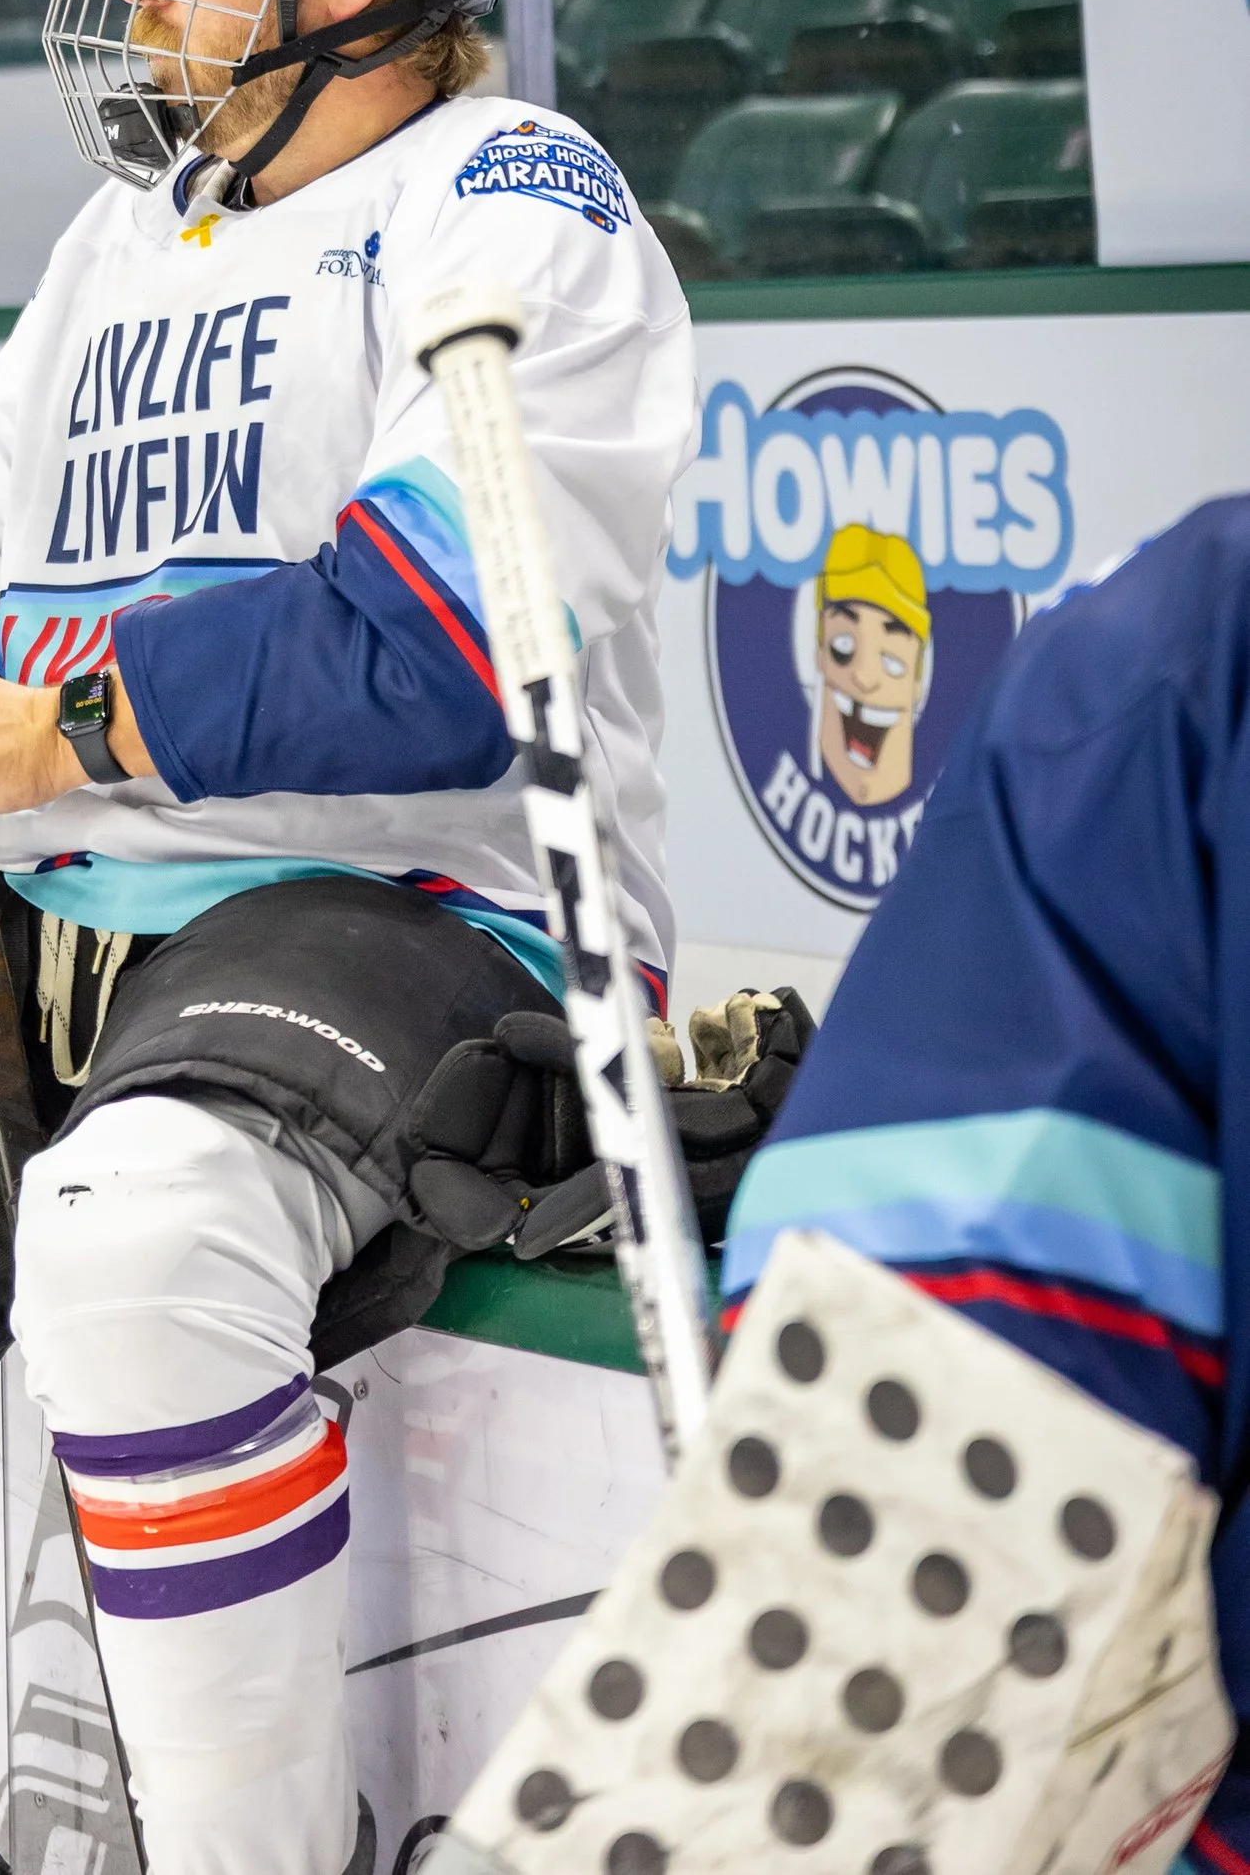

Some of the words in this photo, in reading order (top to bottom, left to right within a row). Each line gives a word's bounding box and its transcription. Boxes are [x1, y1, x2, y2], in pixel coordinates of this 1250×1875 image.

[459, 161, 630, 223] MARATHON
[488, 143, 549, 165] HOUR
[555, 145, 623, 193] HOCKEY
[68, 296, 292, 439] LIVLIFE
[45, 422, 264, 564] LIVFUN
[670, 402, 1062, 570] HOWIES
[762, 749, 926, 887] HOCK
[179, 1001, 386, 1073] SHER-WOOD
